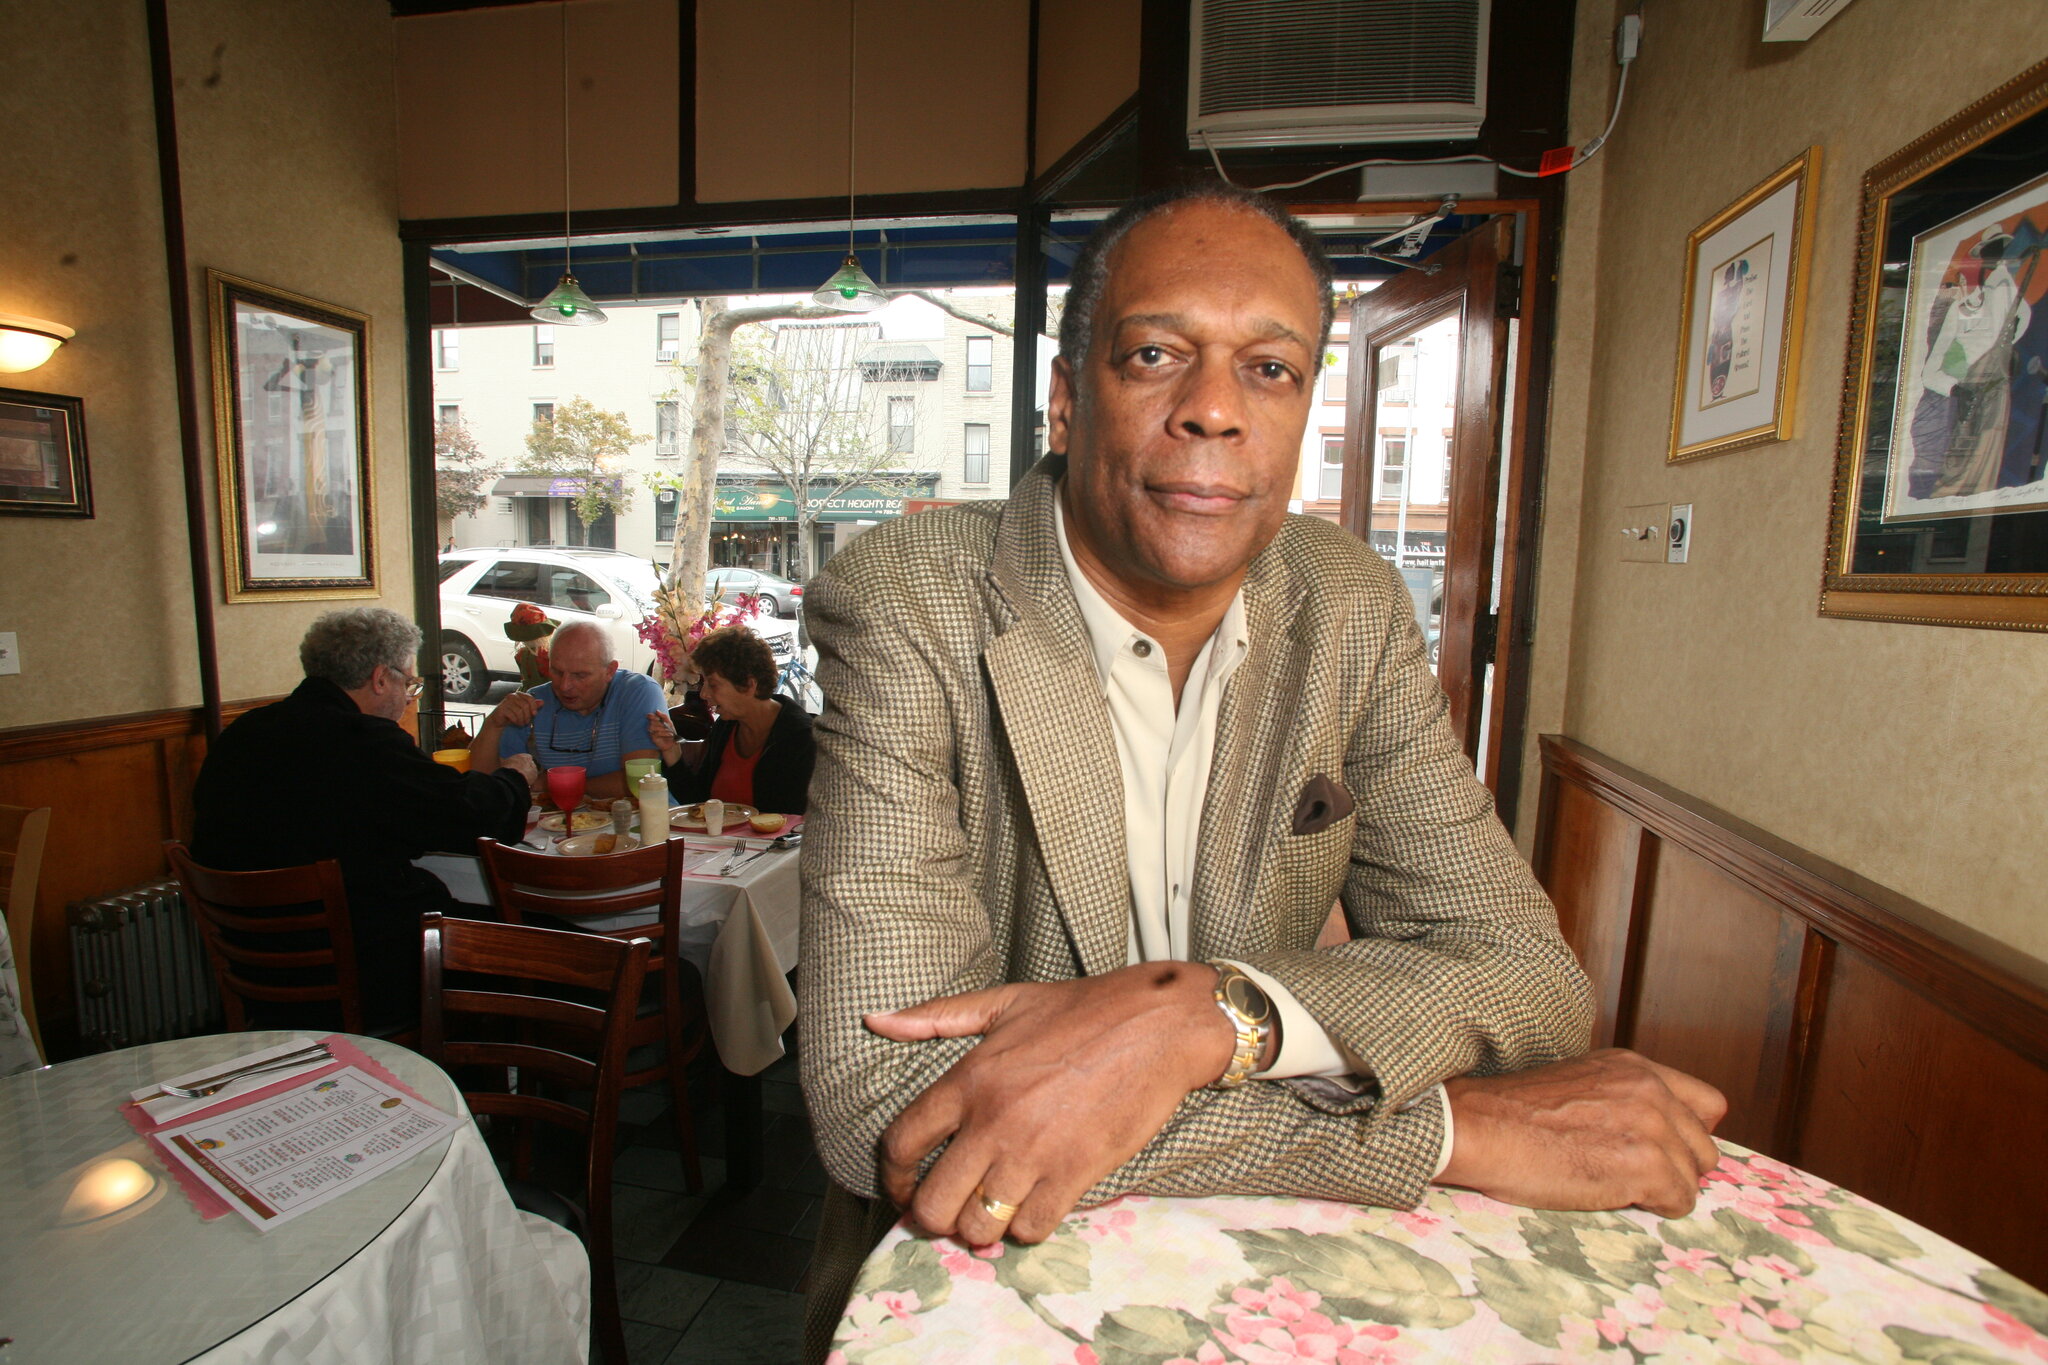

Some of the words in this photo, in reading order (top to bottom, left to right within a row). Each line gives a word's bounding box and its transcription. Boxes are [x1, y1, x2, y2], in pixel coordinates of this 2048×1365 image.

[806, 499, 846, 508] ROSECT
[847, 499, 885, 509] HEIGHTS
[1375, 544, 1430, 553] HATIAN
